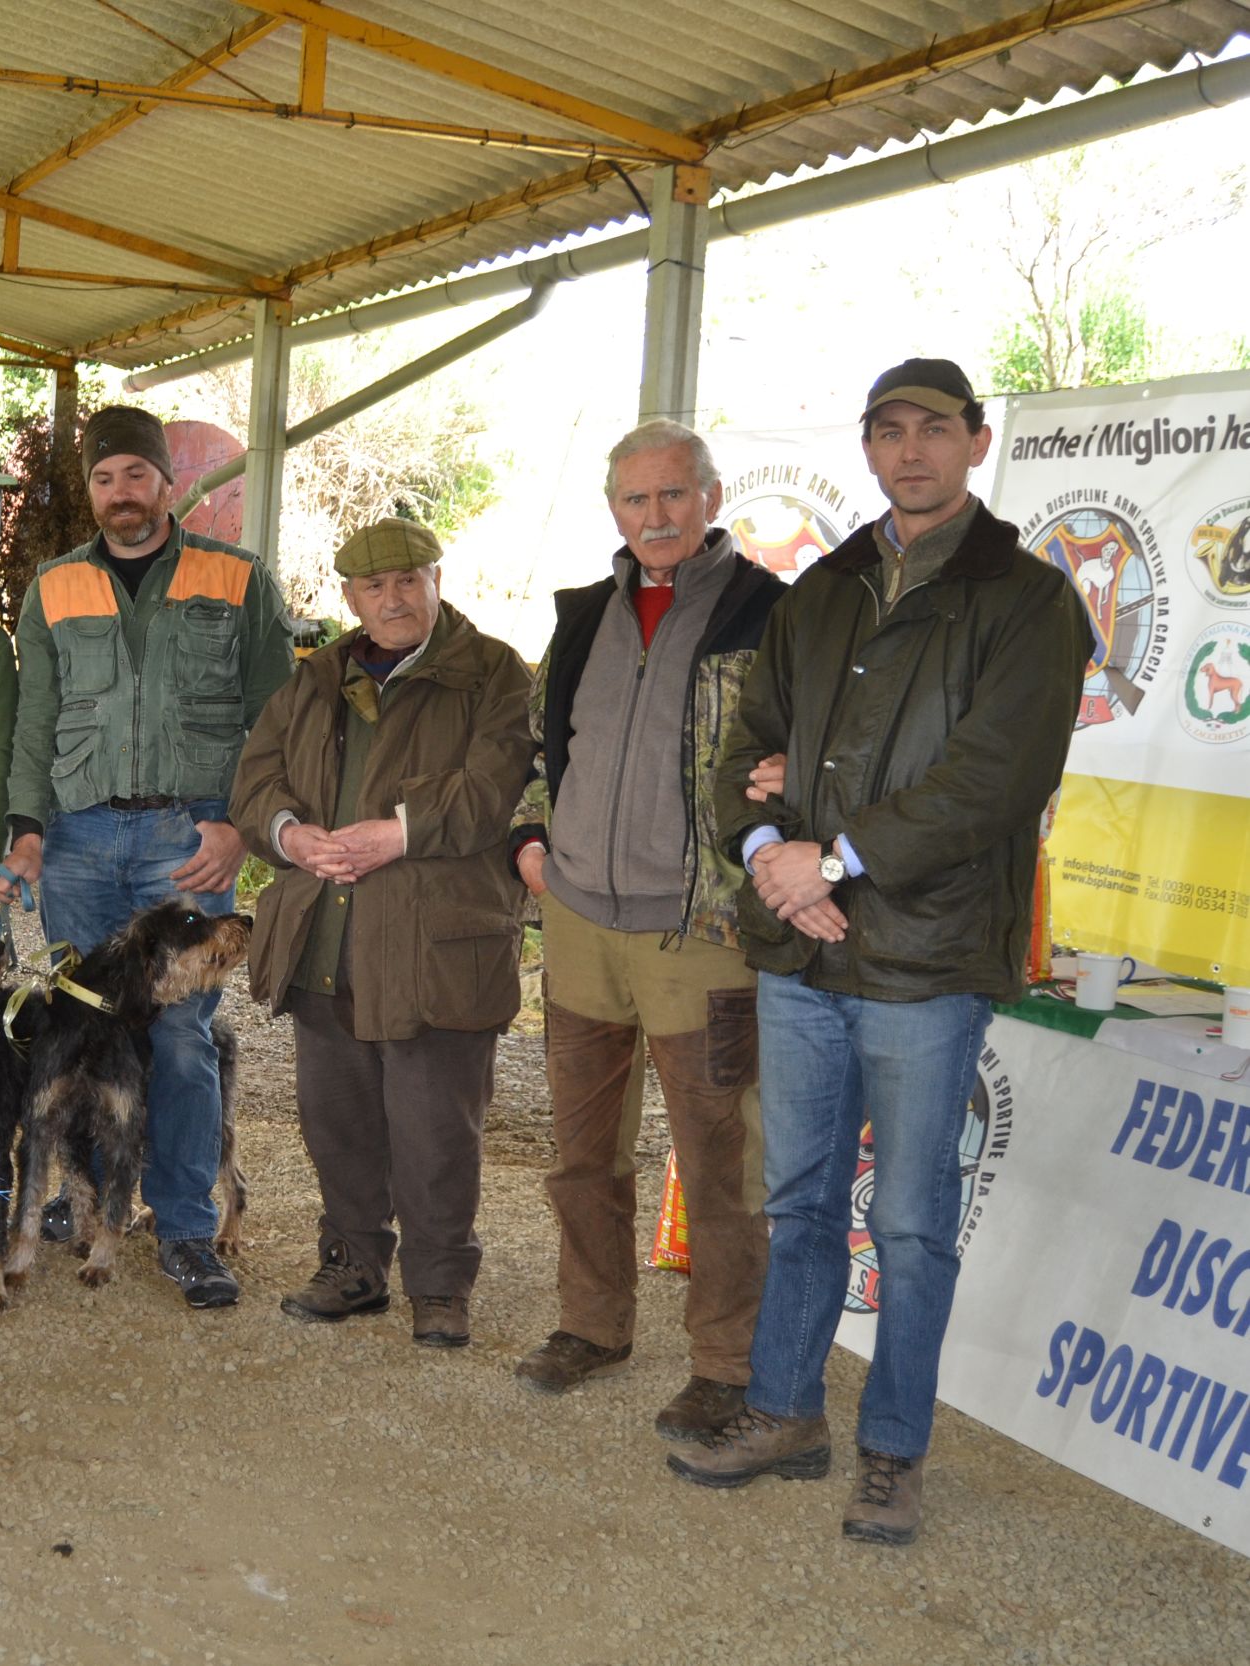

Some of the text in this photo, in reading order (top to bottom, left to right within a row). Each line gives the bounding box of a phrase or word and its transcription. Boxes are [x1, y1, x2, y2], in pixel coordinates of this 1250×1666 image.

[1011, 427, 1081, 461] anche
[1082, 424, 1098, 458] i
[1097, 414, 1217, 466] Migliori
[725, 464, 846, 512] DISCIPLINE ARMI
[1046, 488, 1109, 515] DISCIPLINE
[1114, 494, 1142, 521] ARMI
[1138, 518, 1167, 588] SPORTIVE
[1157, 596, 1170, 617] DA
[1140, 623, 1169, 683] CACCIA
[1162, 879, 1195, 896] (0039)
[1197, 885, 1227, 900] 0534
[1195, 898, 1225, 912] 0534
[988, 1074, 1013, 1161] SPORTIVE
[977, 1170, 997, 1197] DA
[1036, 1320, 1250, 1490] SPORTIVE
